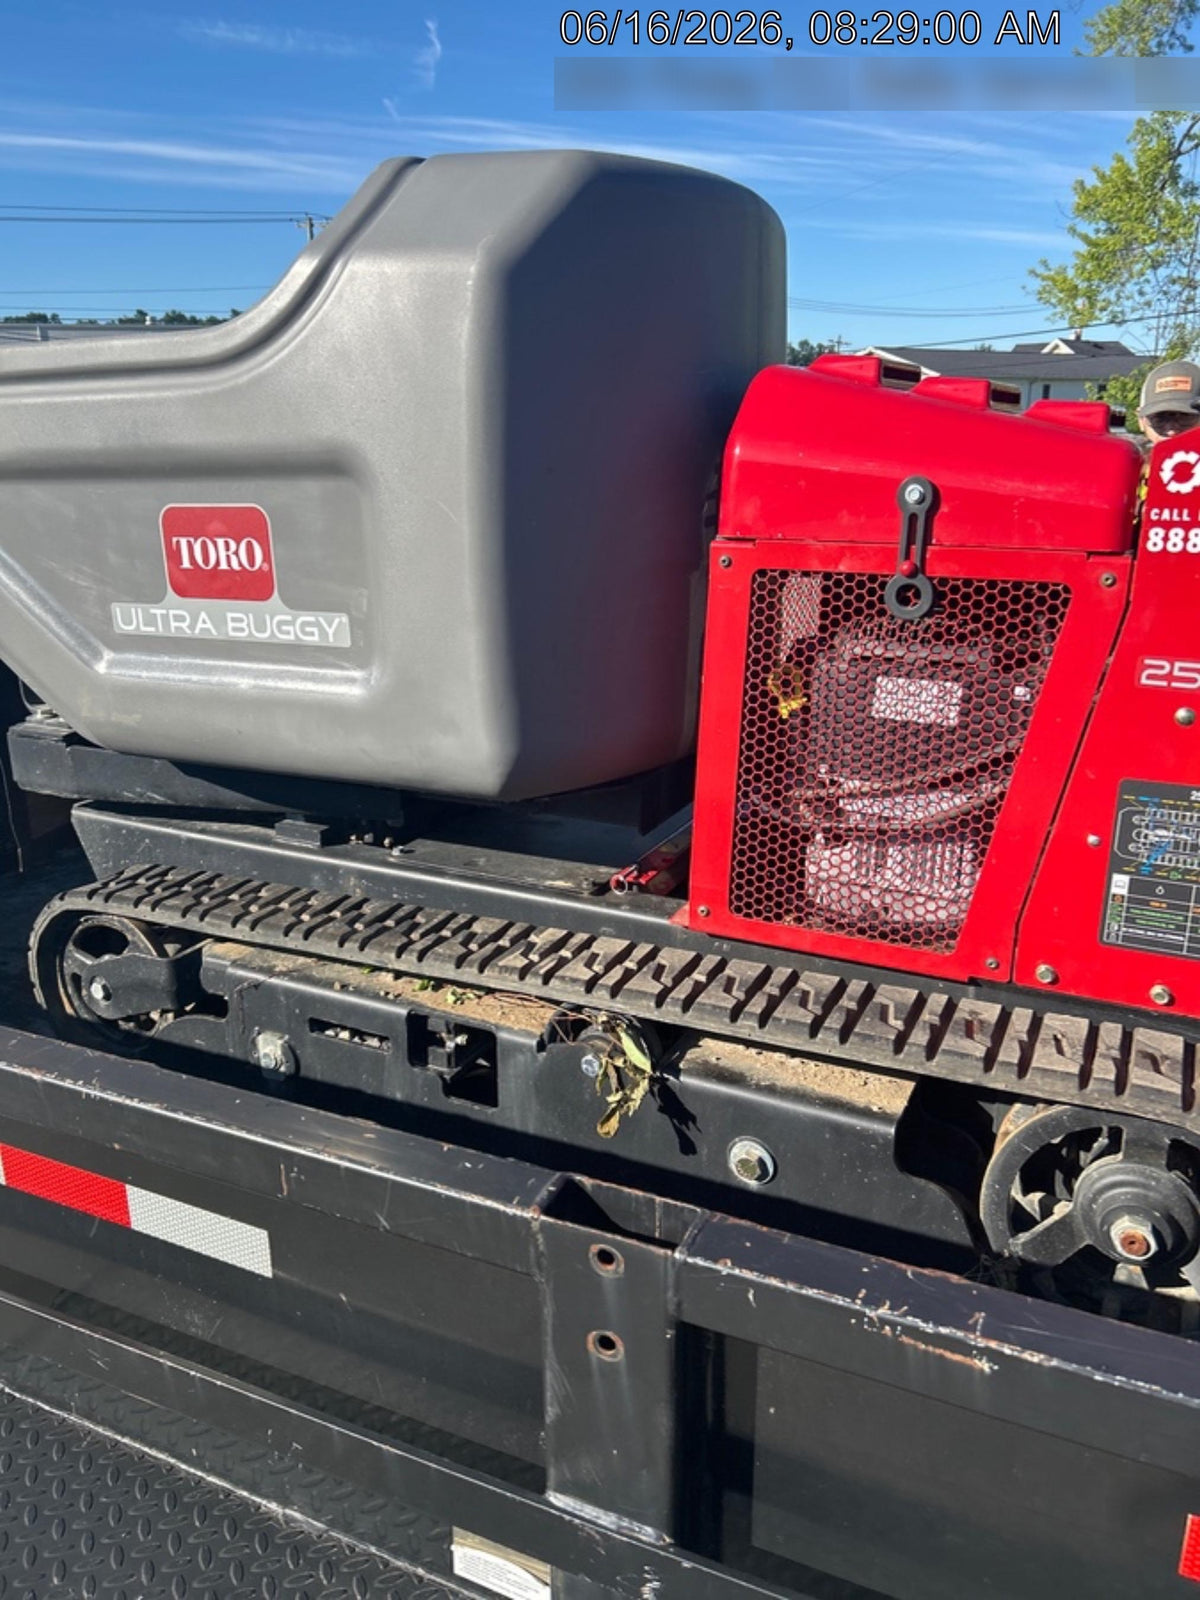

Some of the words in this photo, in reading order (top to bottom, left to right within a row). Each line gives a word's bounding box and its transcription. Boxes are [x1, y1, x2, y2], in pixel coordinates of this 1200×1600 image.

[1150, 508, 1191, 521] CALL
[115, 607, 218, 636] ULTRA
[226, 611, 341, 643] BUGGY
